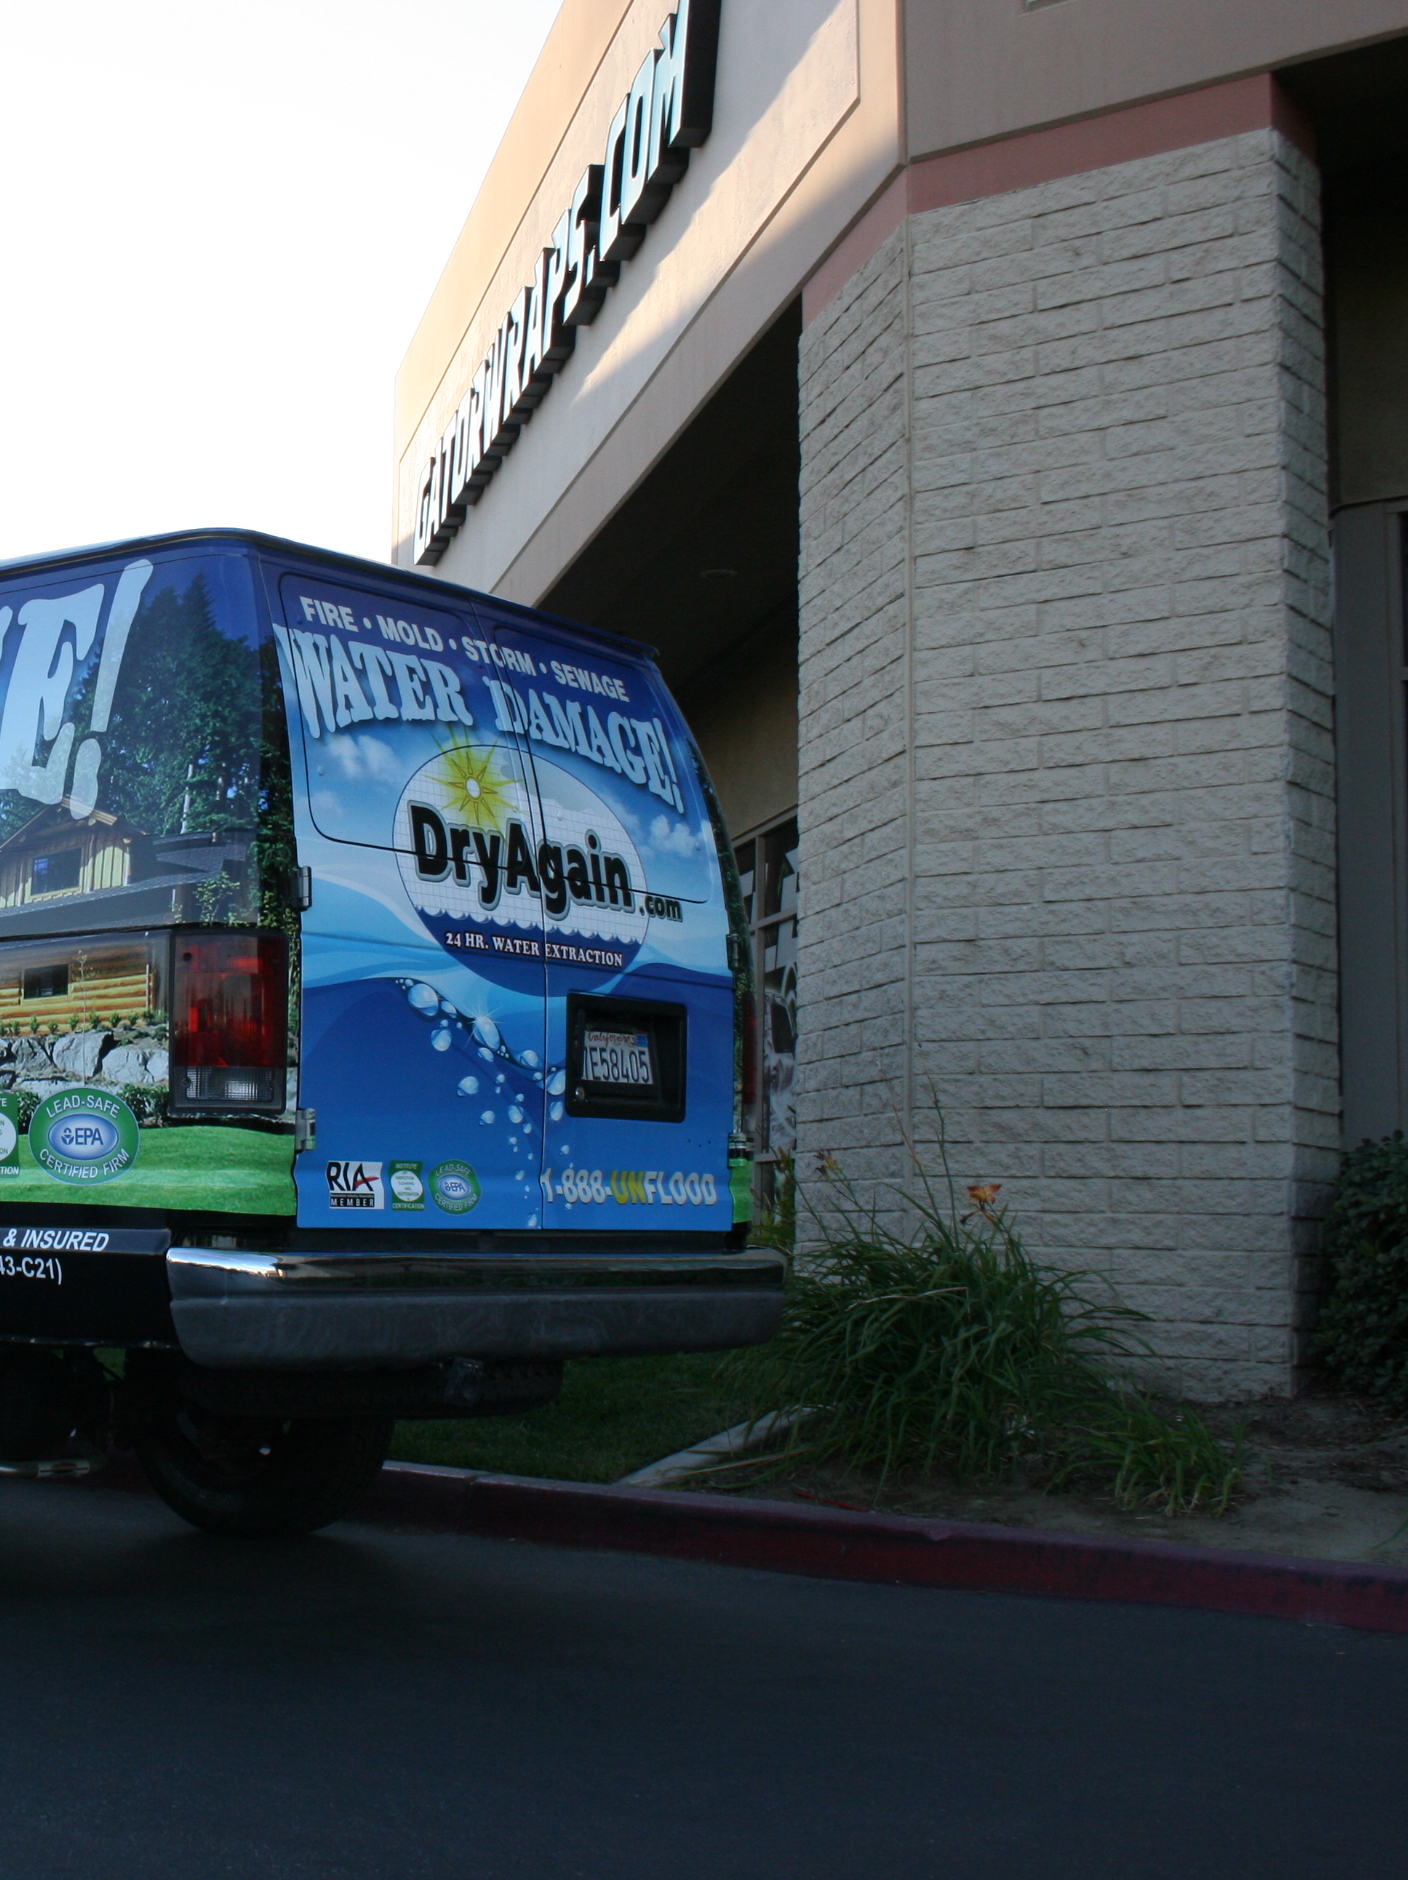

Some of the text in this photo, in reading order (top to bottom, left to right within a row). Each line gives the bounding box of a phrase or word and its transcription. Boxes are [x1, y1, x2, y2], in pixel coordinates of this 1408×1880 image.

[300, 596, 630, 702] FIRE MOLD STORM SEWAGE
[273, 623, 684, 814] WATER DAMAGE!
[446, 932, 623, 966] 24 HR. WATER EXTRACTION
[46, 1095, 121, 1119] LEAD-SAFE
[75, 1128, 104, 1146] EPA
[39, 1148, 130, 1179] CERTIFIED FIRM
[327, 1162, 374, 1191] RIA
[330, 1198, 374, 1206] MEMBER
[540, 1168, 717, 1206] 1-888-UNFLOOD
[3, 1228, 17, 1247] &
[21, 1229, 110, 1252] INSURED
